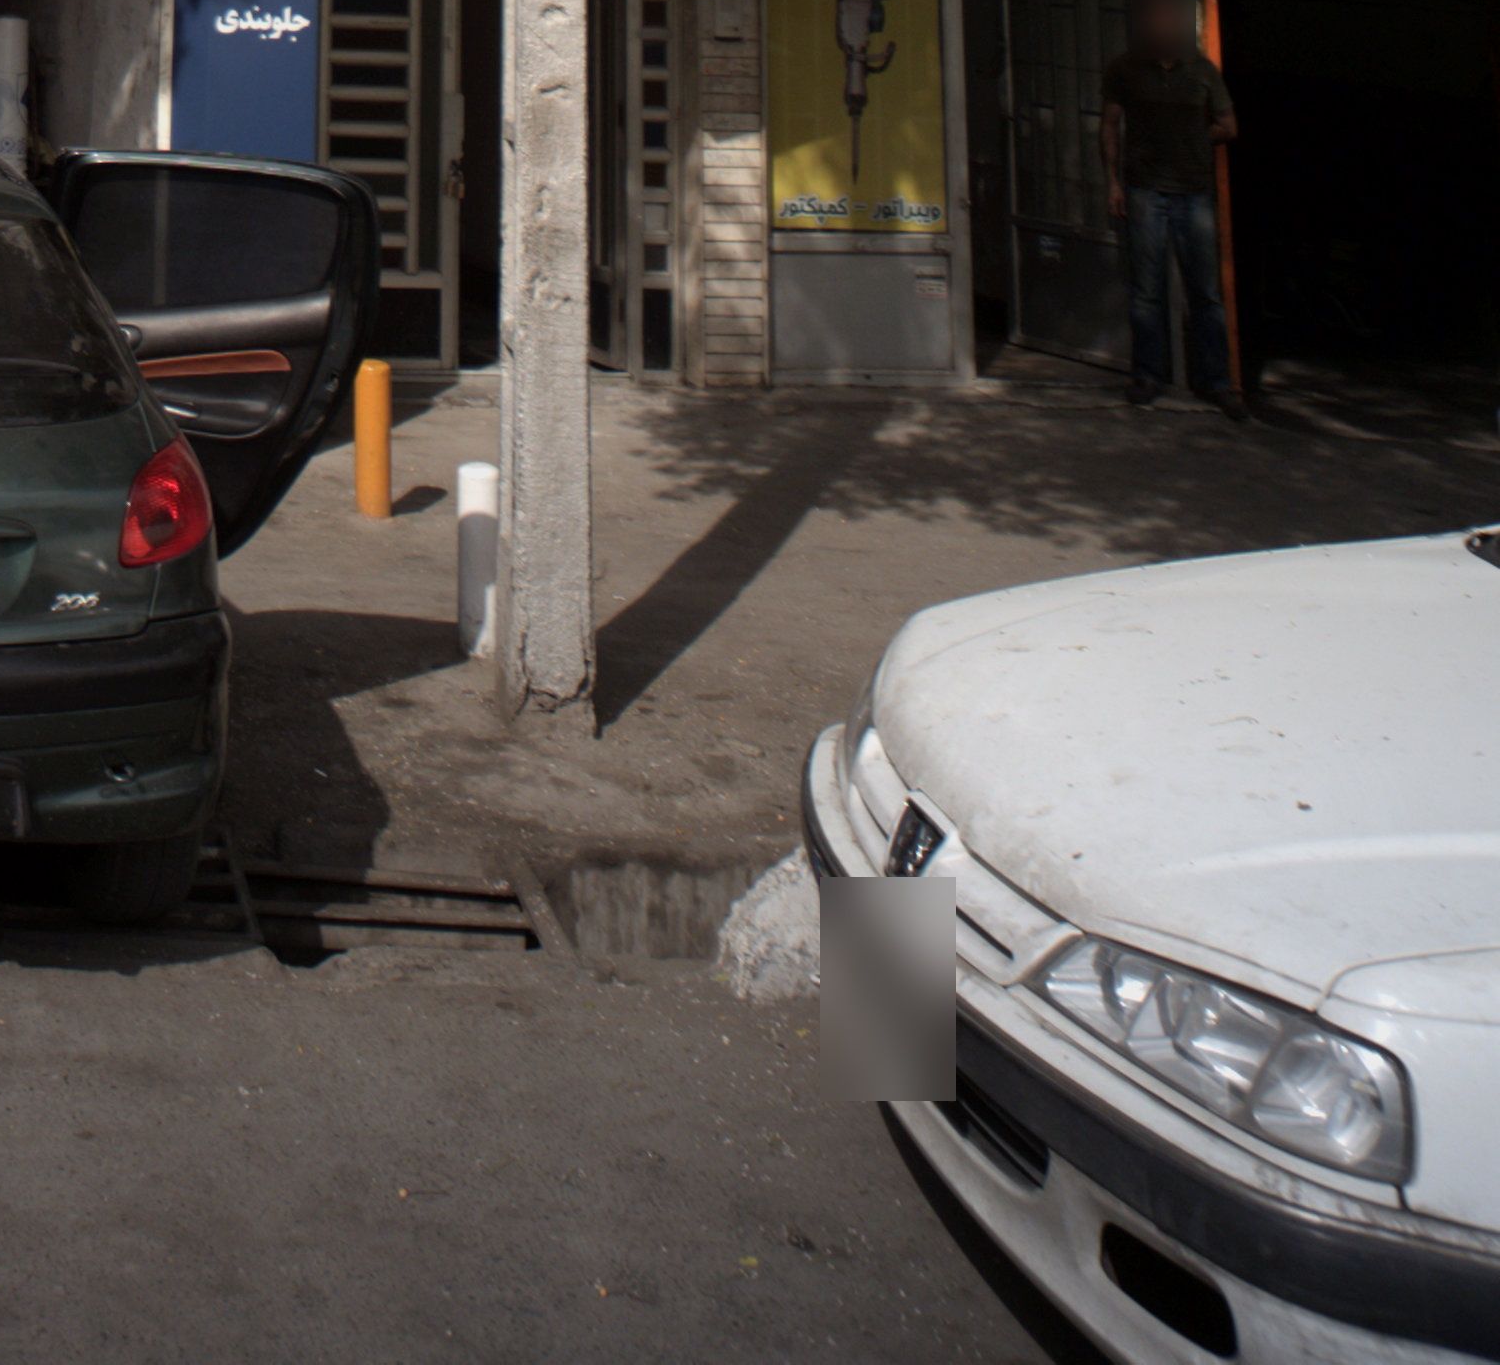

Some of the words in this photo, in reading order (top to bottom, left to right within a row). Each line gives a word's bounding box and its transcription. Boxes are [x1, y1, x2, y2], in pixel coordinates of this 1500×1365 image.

[214, 5, 311, 42] جلوبندی
[779, 196, 849, 224] کمپکتور
[874, 197, 941, 224] ویبراتور
